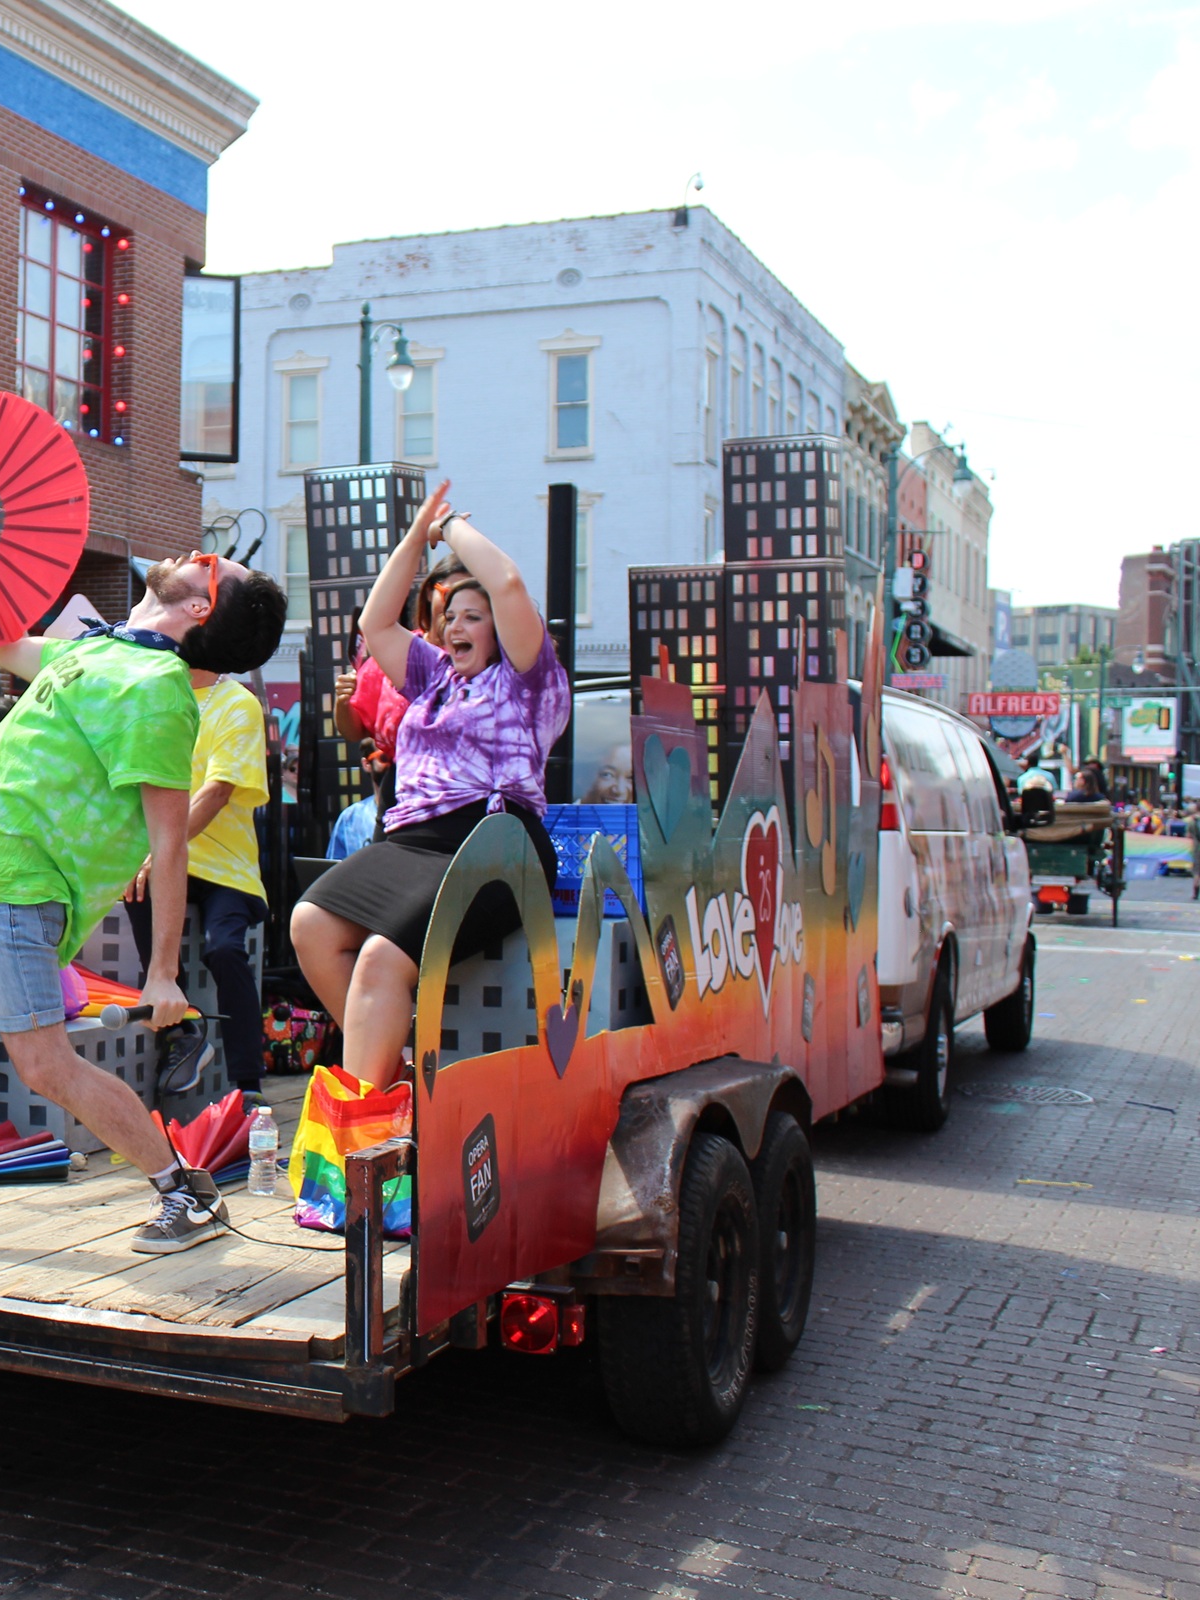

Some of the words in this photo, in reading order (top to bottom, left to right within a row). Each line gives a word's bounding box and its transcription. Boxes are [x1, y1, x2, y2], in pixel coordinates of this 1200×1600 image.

[971, 694, 1057, 714] ALFRED'S
[468, 1135, 489, 1166] OPERA
[470, 1158, 492, 1201] FAN
